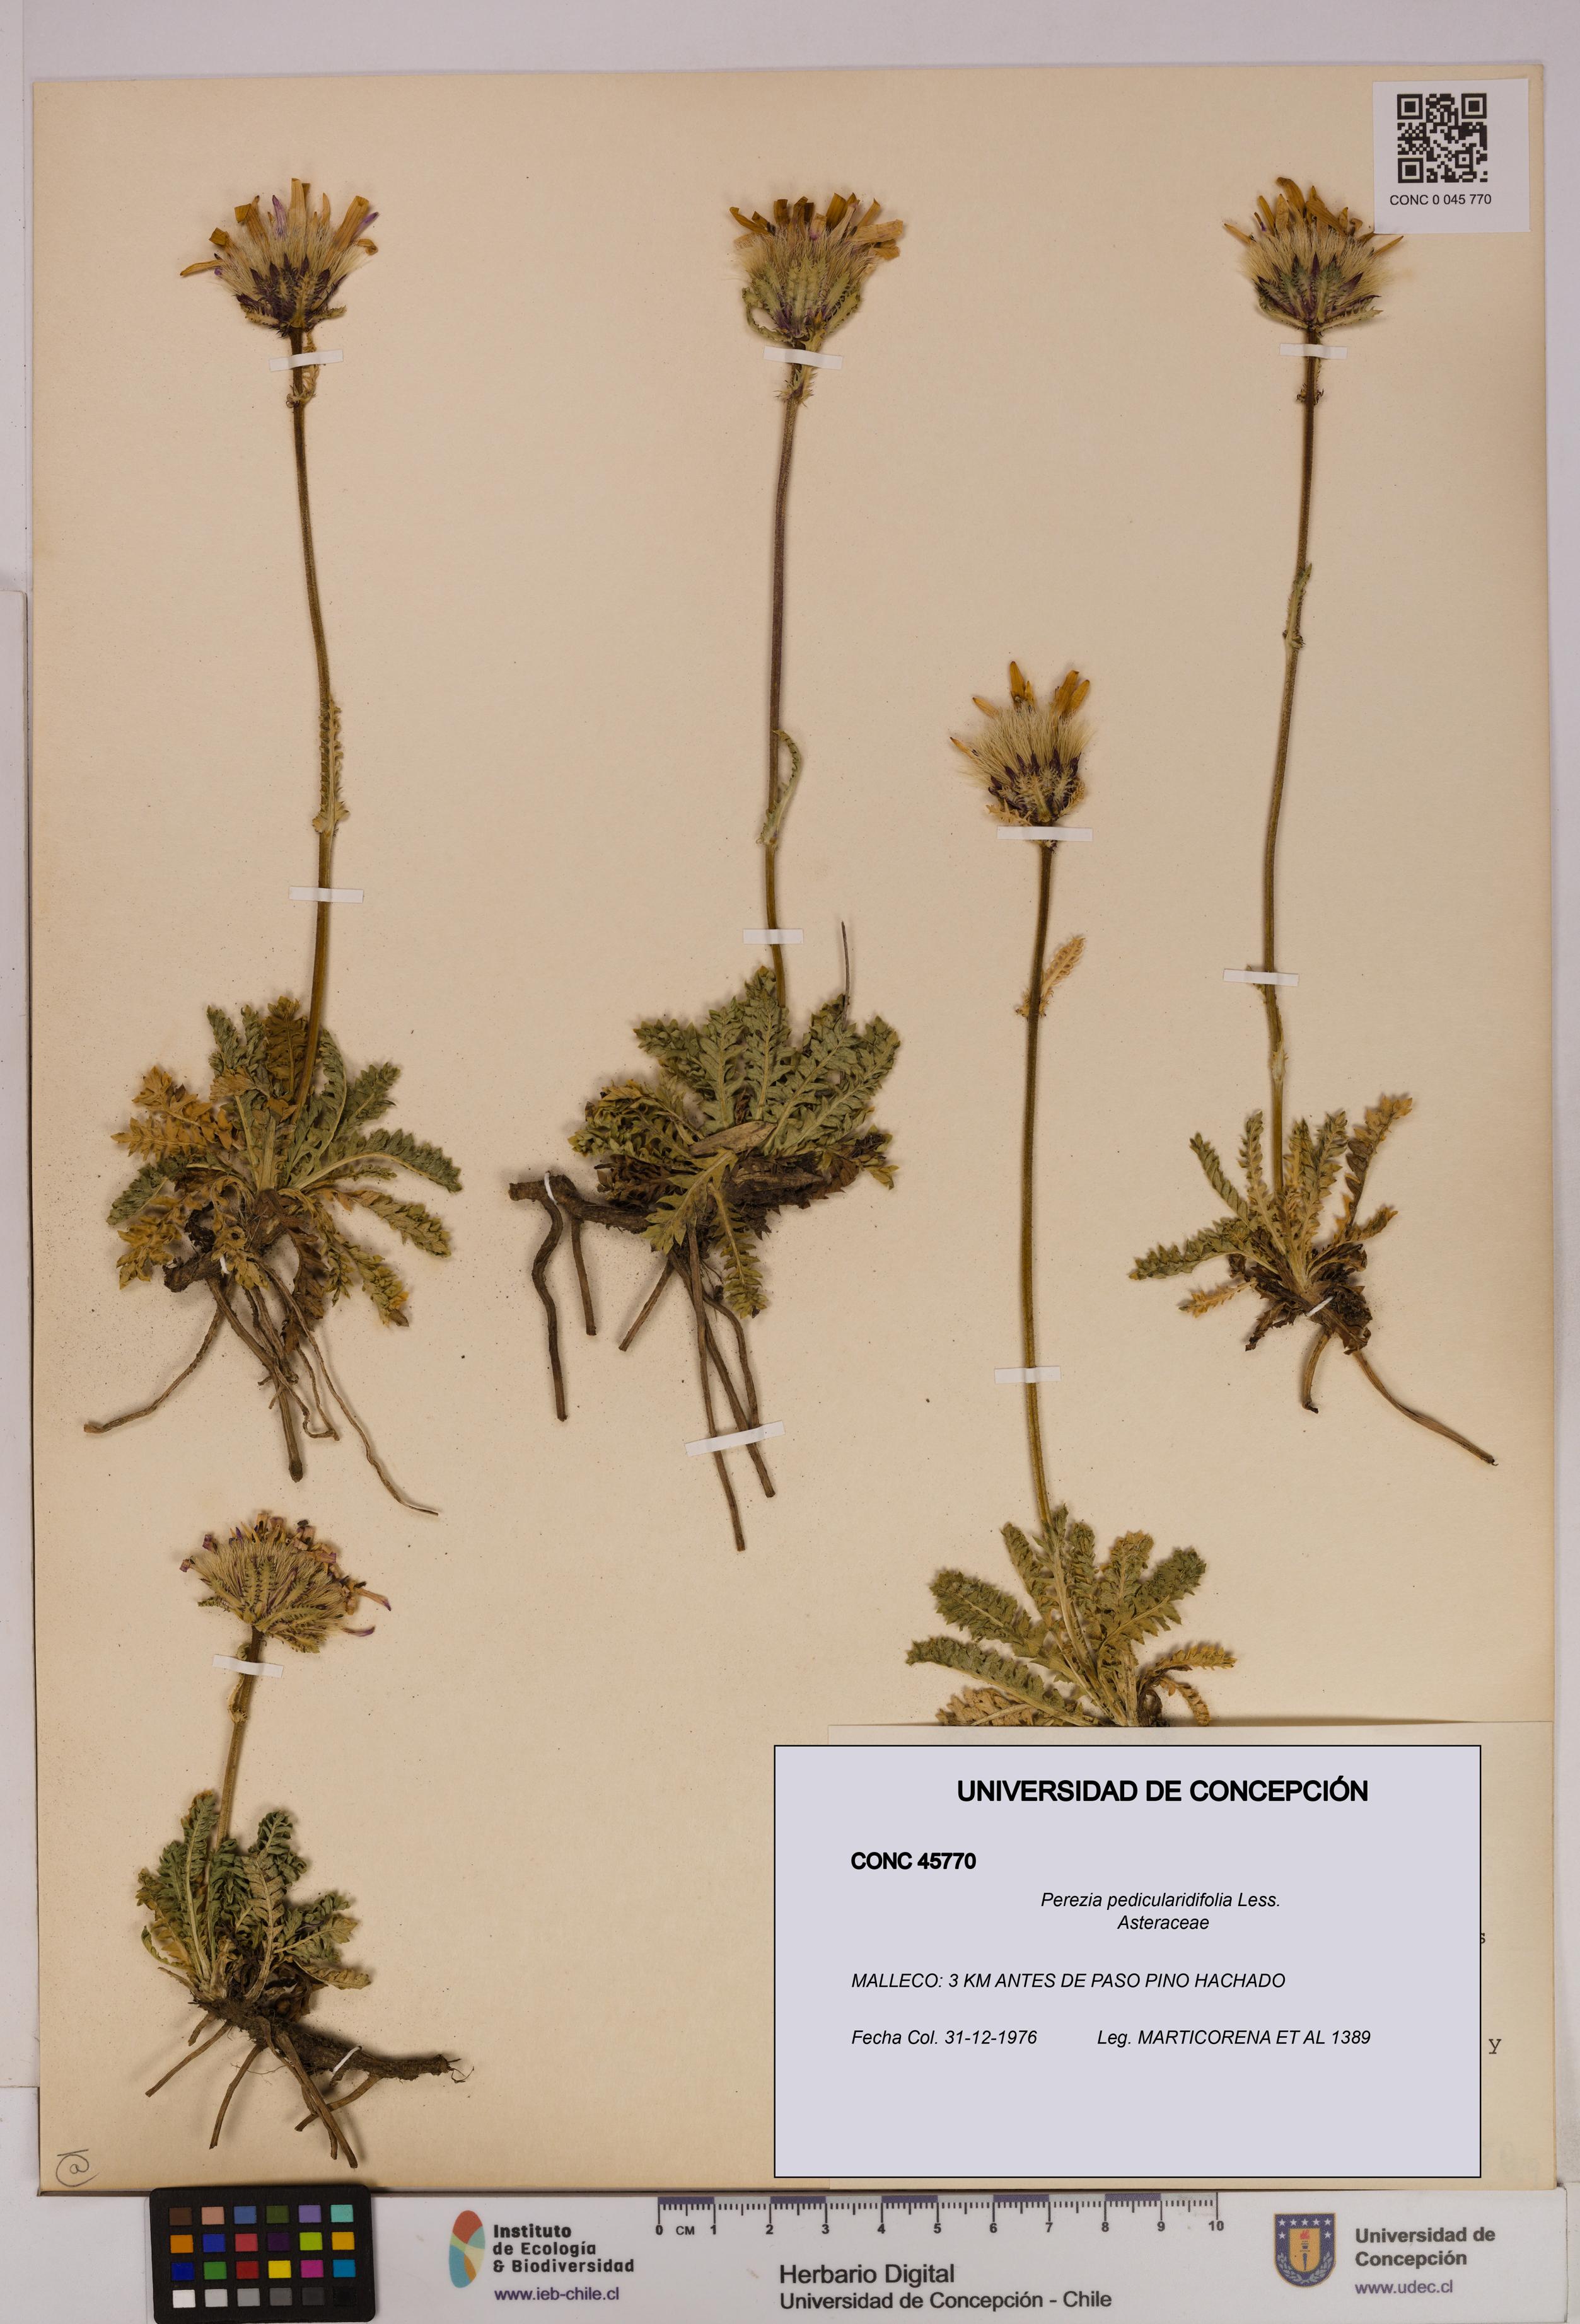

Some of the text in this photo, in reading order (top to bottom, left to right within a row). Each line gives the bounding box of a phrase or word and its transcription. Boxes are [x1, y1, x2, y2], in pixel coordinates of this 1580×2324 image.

[1390, 194, 1492, 205] CONC 0 045 770
[494, 2223, 572, 2238] Instituto
[655, 2220, 1224, 2236] 0 CM 1 2 3 4 5 6 7 8 9 10
[1356, 2226, 1496, 2243] Universidad de
[492, 2241, 596, 2258] de Ecología
[492, 2258, 634, 2273] & Biodiversidad
[1355, 2250, 1467, 2270] Concepción
[780, 2263, 955, 2288] Herbario Digital
[494, 2286, 619, 2301] www.ieb-chile.cl
[1354, 2279, 1453, 2294] www.udec.cl
[780, 2292, 893, 2310] Universidad
[899, 2292, 924, 2309] de
[929, 2291, 1043, 2312] Concepción
[1063, 2290, 1112, 2308] Chile
